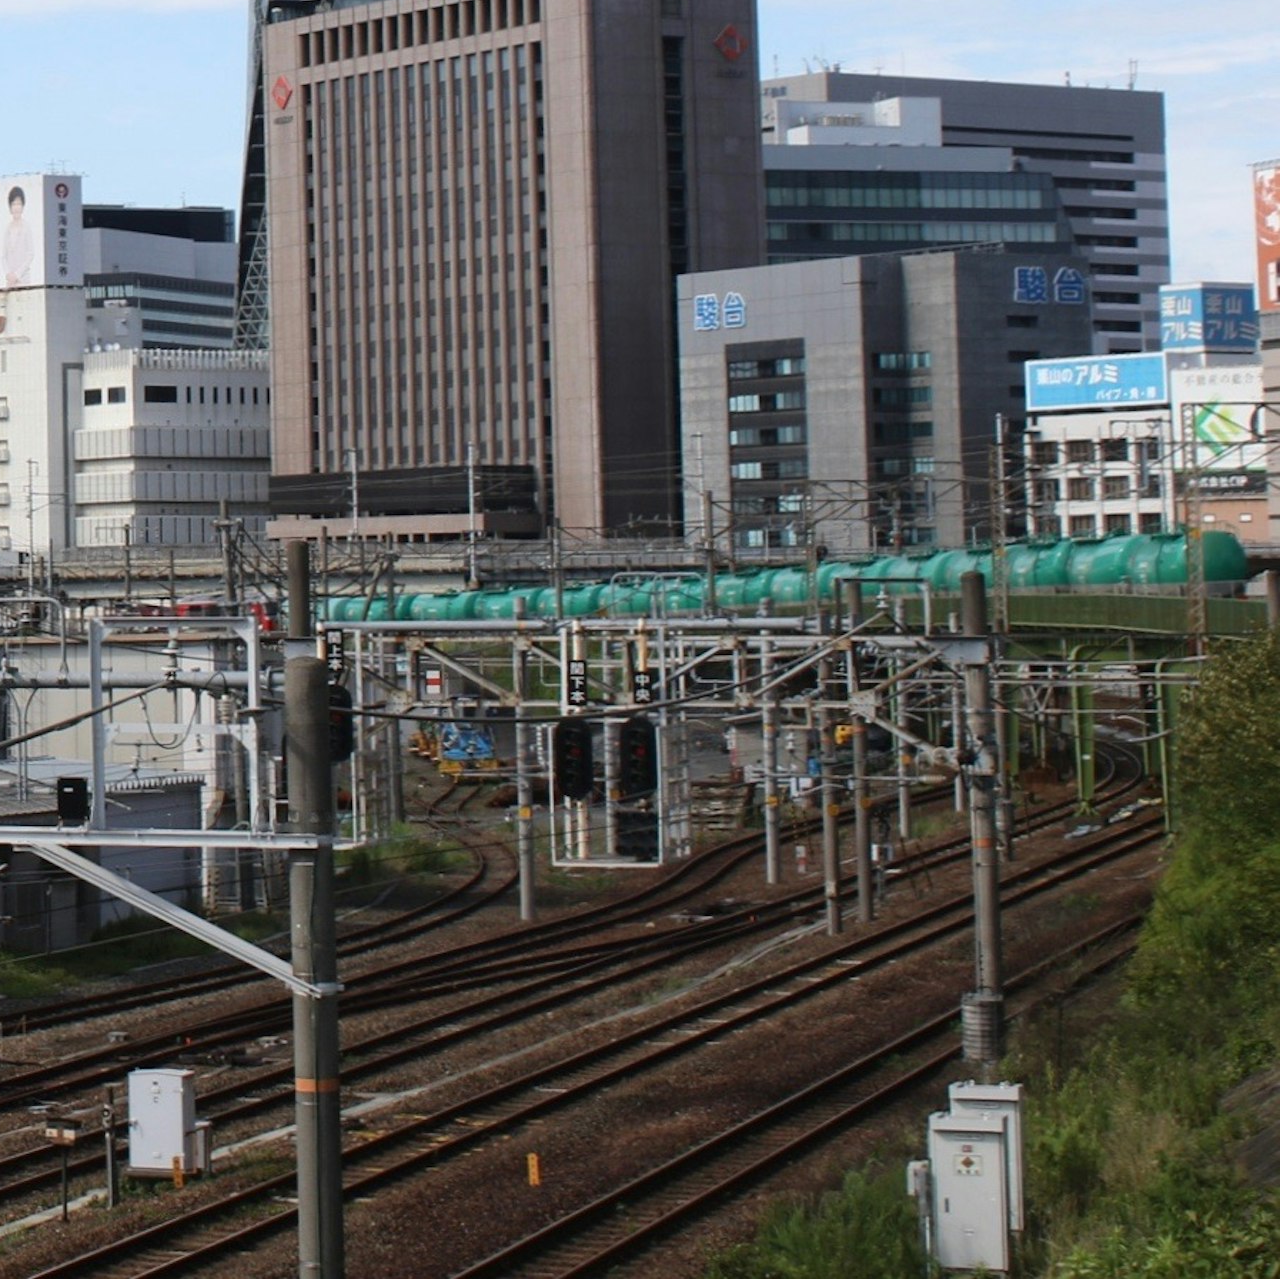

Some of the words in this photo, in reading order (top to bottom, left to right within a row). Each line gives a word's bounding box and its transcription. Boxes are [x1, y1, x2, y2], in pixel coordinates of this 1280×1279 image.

[57, 202, 68, 277] 東海東京証券
[1013, 267, 1085, 304] 駿台
[693, 292, 747, 330] 駿台
[1161, 322, 1203, 342] アルミ
[634, 674, 651, 703] 中央
